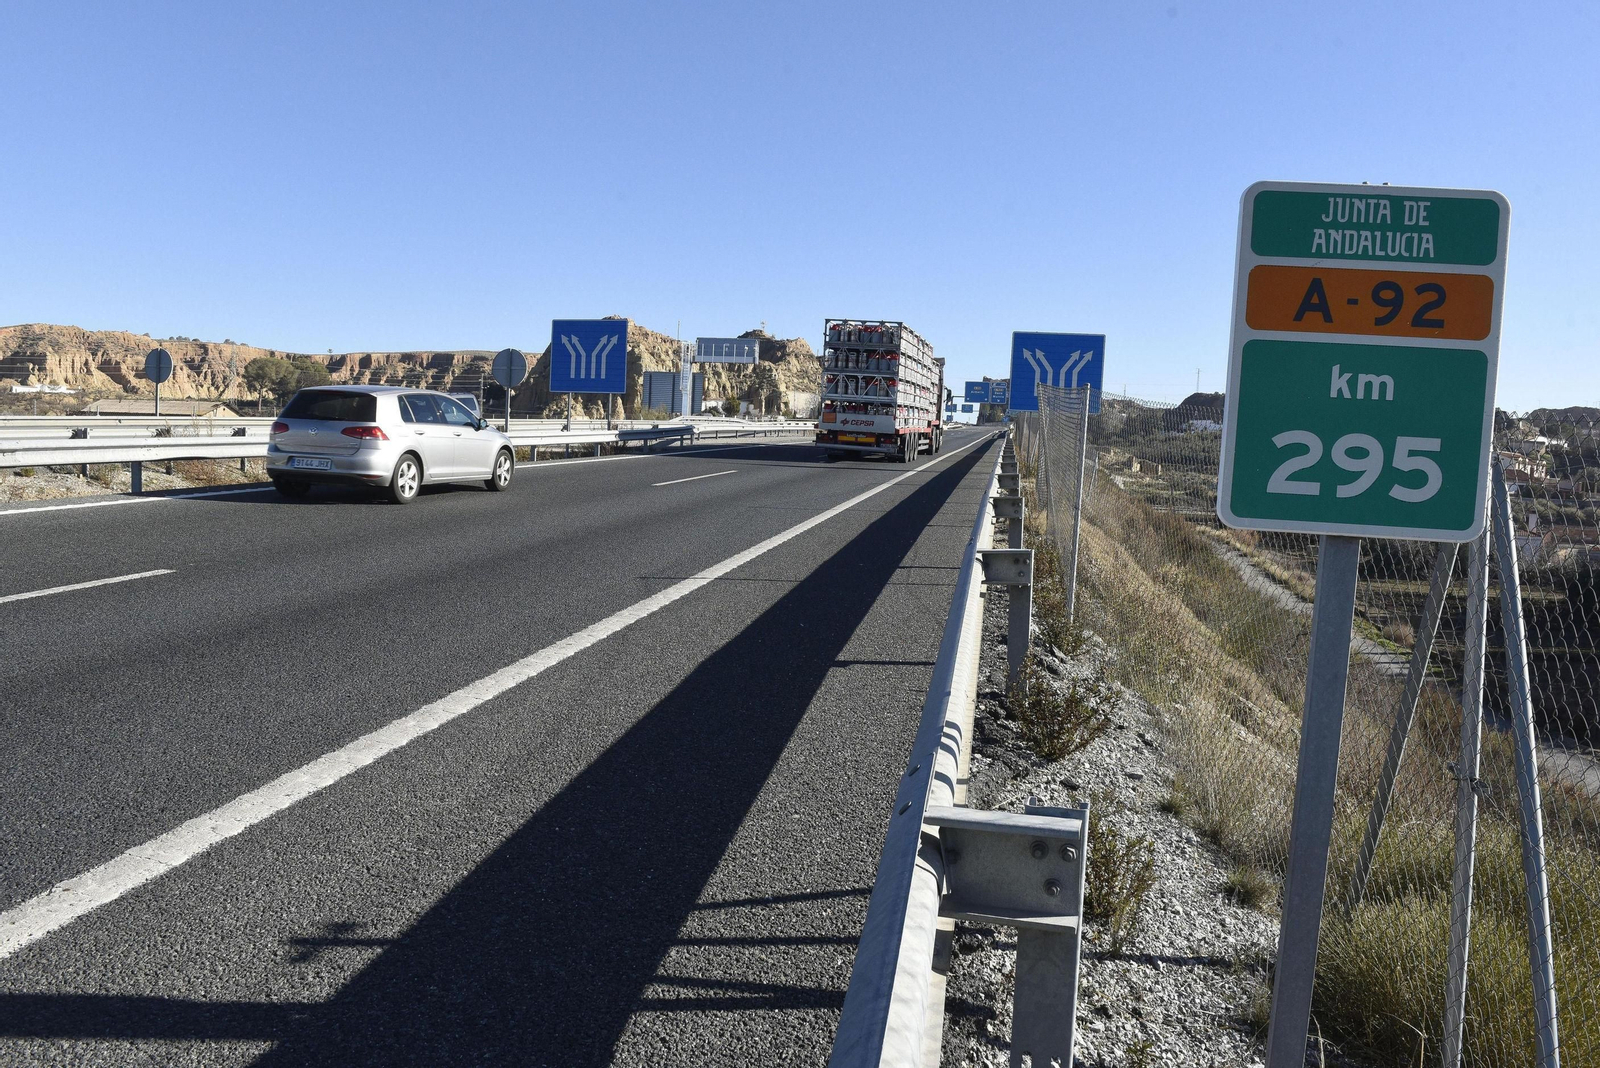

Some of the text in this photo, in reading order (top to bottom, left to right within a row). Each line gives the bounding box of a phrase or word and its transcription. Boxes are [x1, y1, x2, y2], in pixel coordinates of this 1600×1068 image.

[1321, 197, 1431, 226] JUNTA DE
[1311, 228, 1435, 258] ANDALUCIA
[1292, 277, 1447, 329] A-92
[1330, 364, 1395, 401] km
[850, 419, 875, 427] CEPSA
[295, 459, 314, 467] 9144
[1266, 430, 1443, 503] 295
